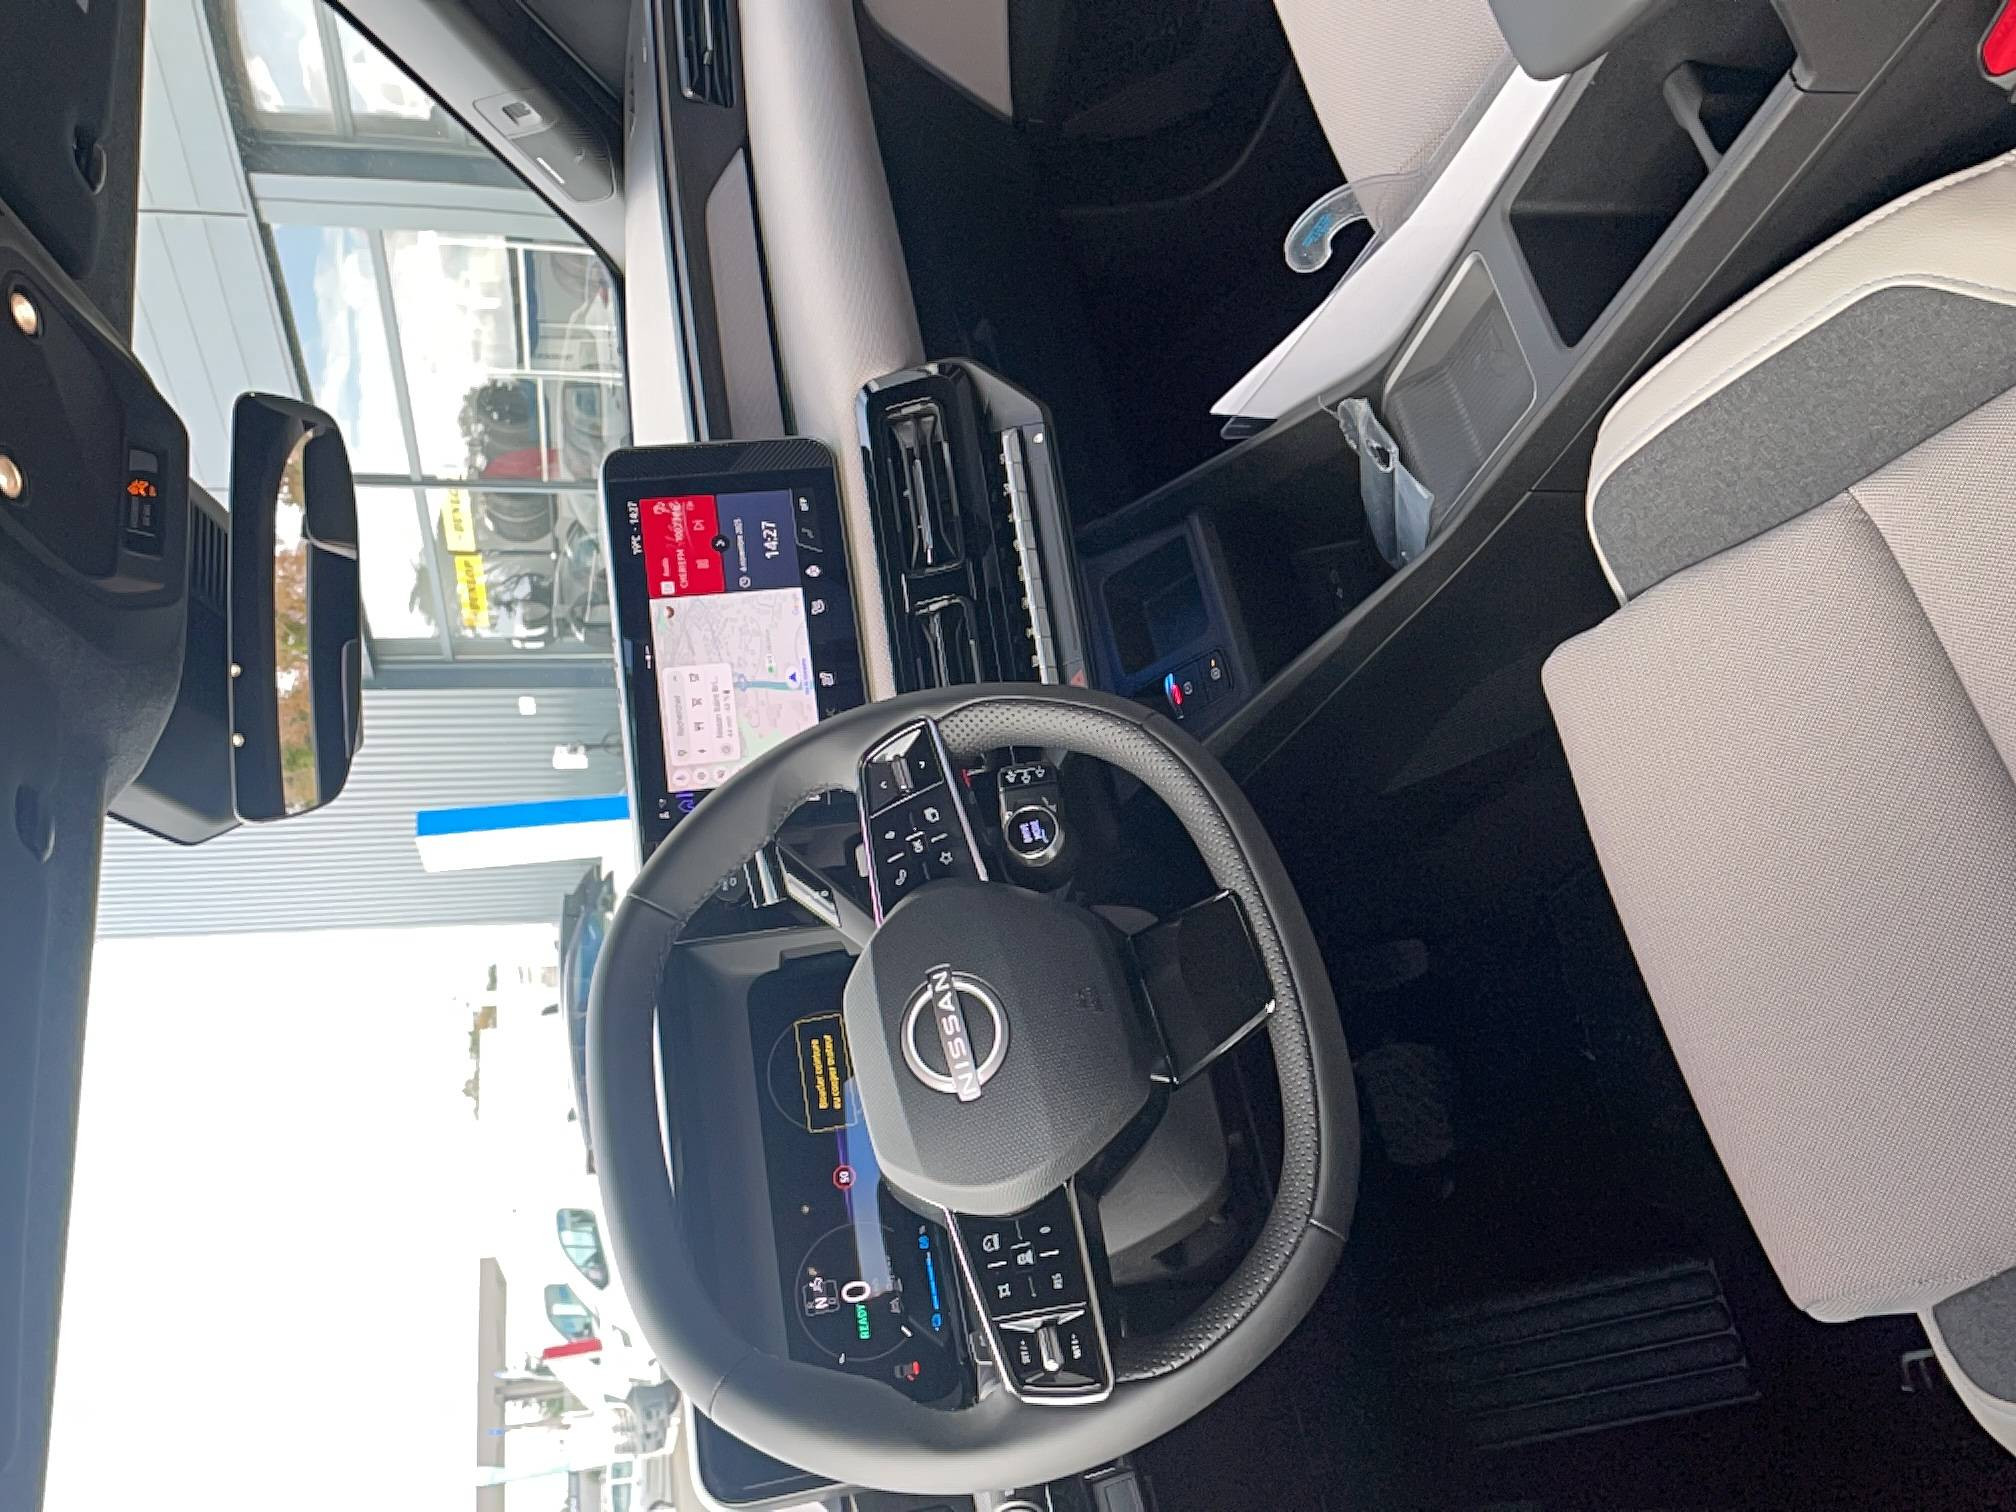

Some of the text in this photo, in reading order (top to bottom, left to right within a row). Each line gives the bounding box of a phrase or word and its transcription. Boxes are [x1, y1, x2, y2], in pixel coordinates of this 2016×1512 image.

[448, 488, 464, 532] DUNLO
[627, 501, 639, 524] 14:27
[761, 521, 779, 559] 14:27
[912, 839, 923, 853] OK
[932, 970, 980, 1096] NISSAN
[839, 1171, 850, 1184] 50
[841, 1280, 871, 1303] 0
[1052, 1273, 1063, 1290] RES
[815, 1297, 829, 1309] N
[856, 1304, 870, 1339] READY
